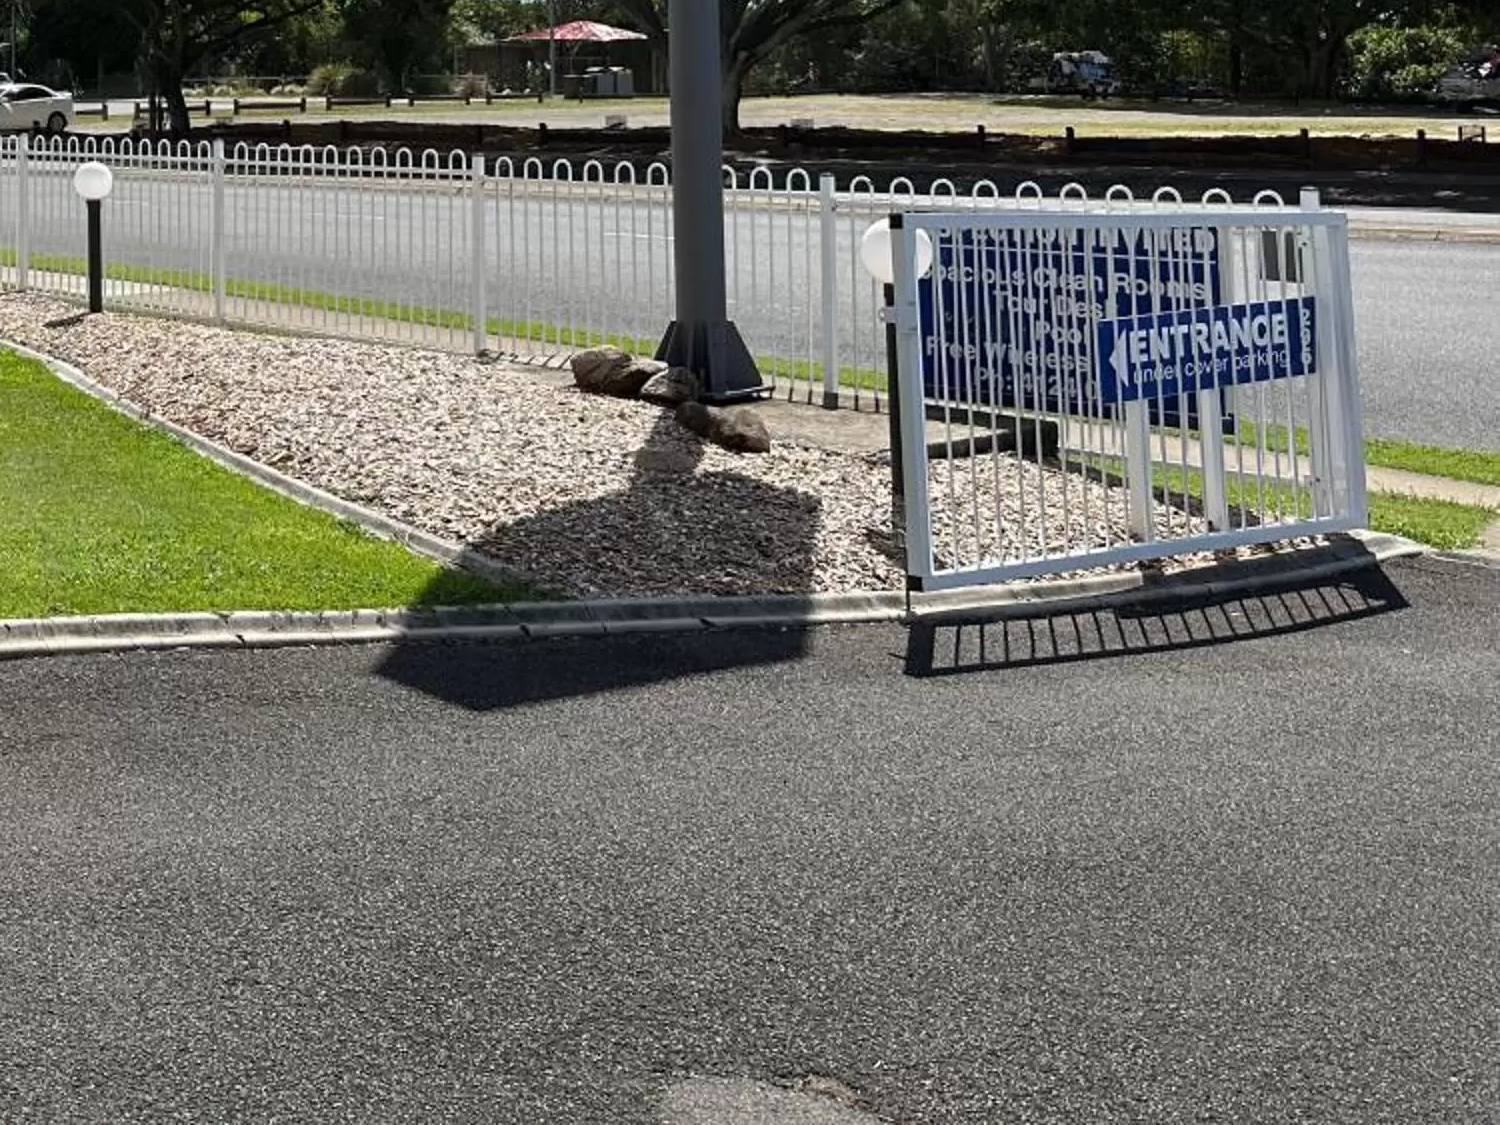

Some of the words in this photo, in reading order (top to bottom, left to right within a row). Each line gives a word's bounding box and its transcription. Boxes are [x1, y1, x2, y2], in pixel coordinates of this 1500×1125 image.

[922, 263, 1025, 287] pacous
[1115, 272, 1206, 301] Rooms
[1128, 312, 1287, 364] ENTRANCE
